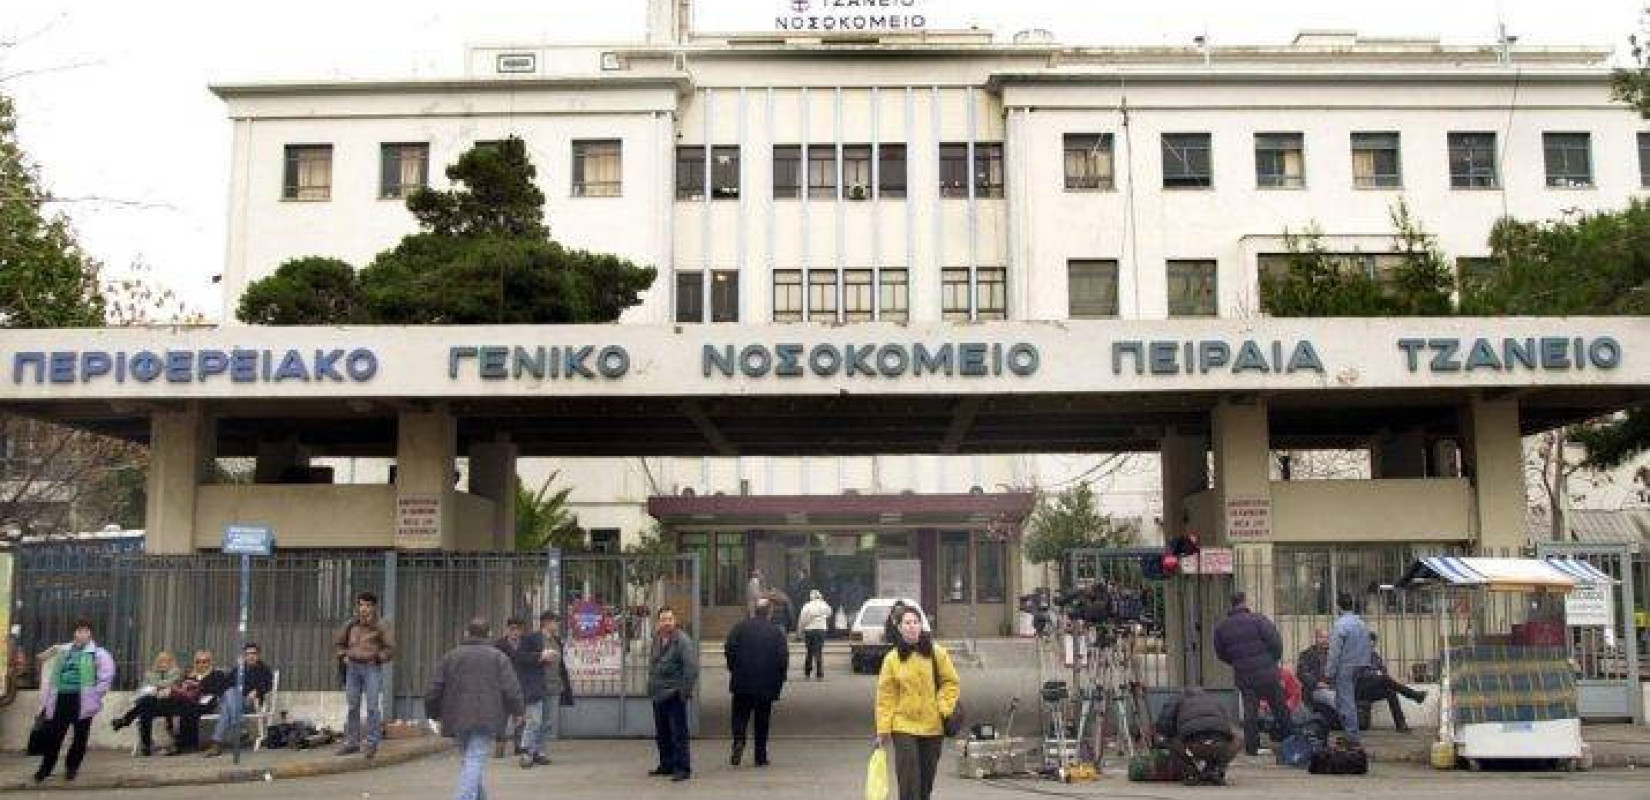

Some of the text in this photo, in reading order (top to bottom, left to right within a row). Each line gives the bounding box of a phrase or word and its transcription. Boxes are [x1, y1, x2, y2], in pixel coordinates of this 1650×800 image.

[775, 15, 926, 29] ΝΟΣΟΚΟΜΕΙΟ
[12, 336, 1622, 385] ΠΕΡΙΦΕΡΕΙΑΚΟ ΓΕΝΙΚΟ ΝΟΣΟΚΟΜΕΙΟ ΠΕΙΡΑΙΑ ΤΖΑΝΕΙΟ
